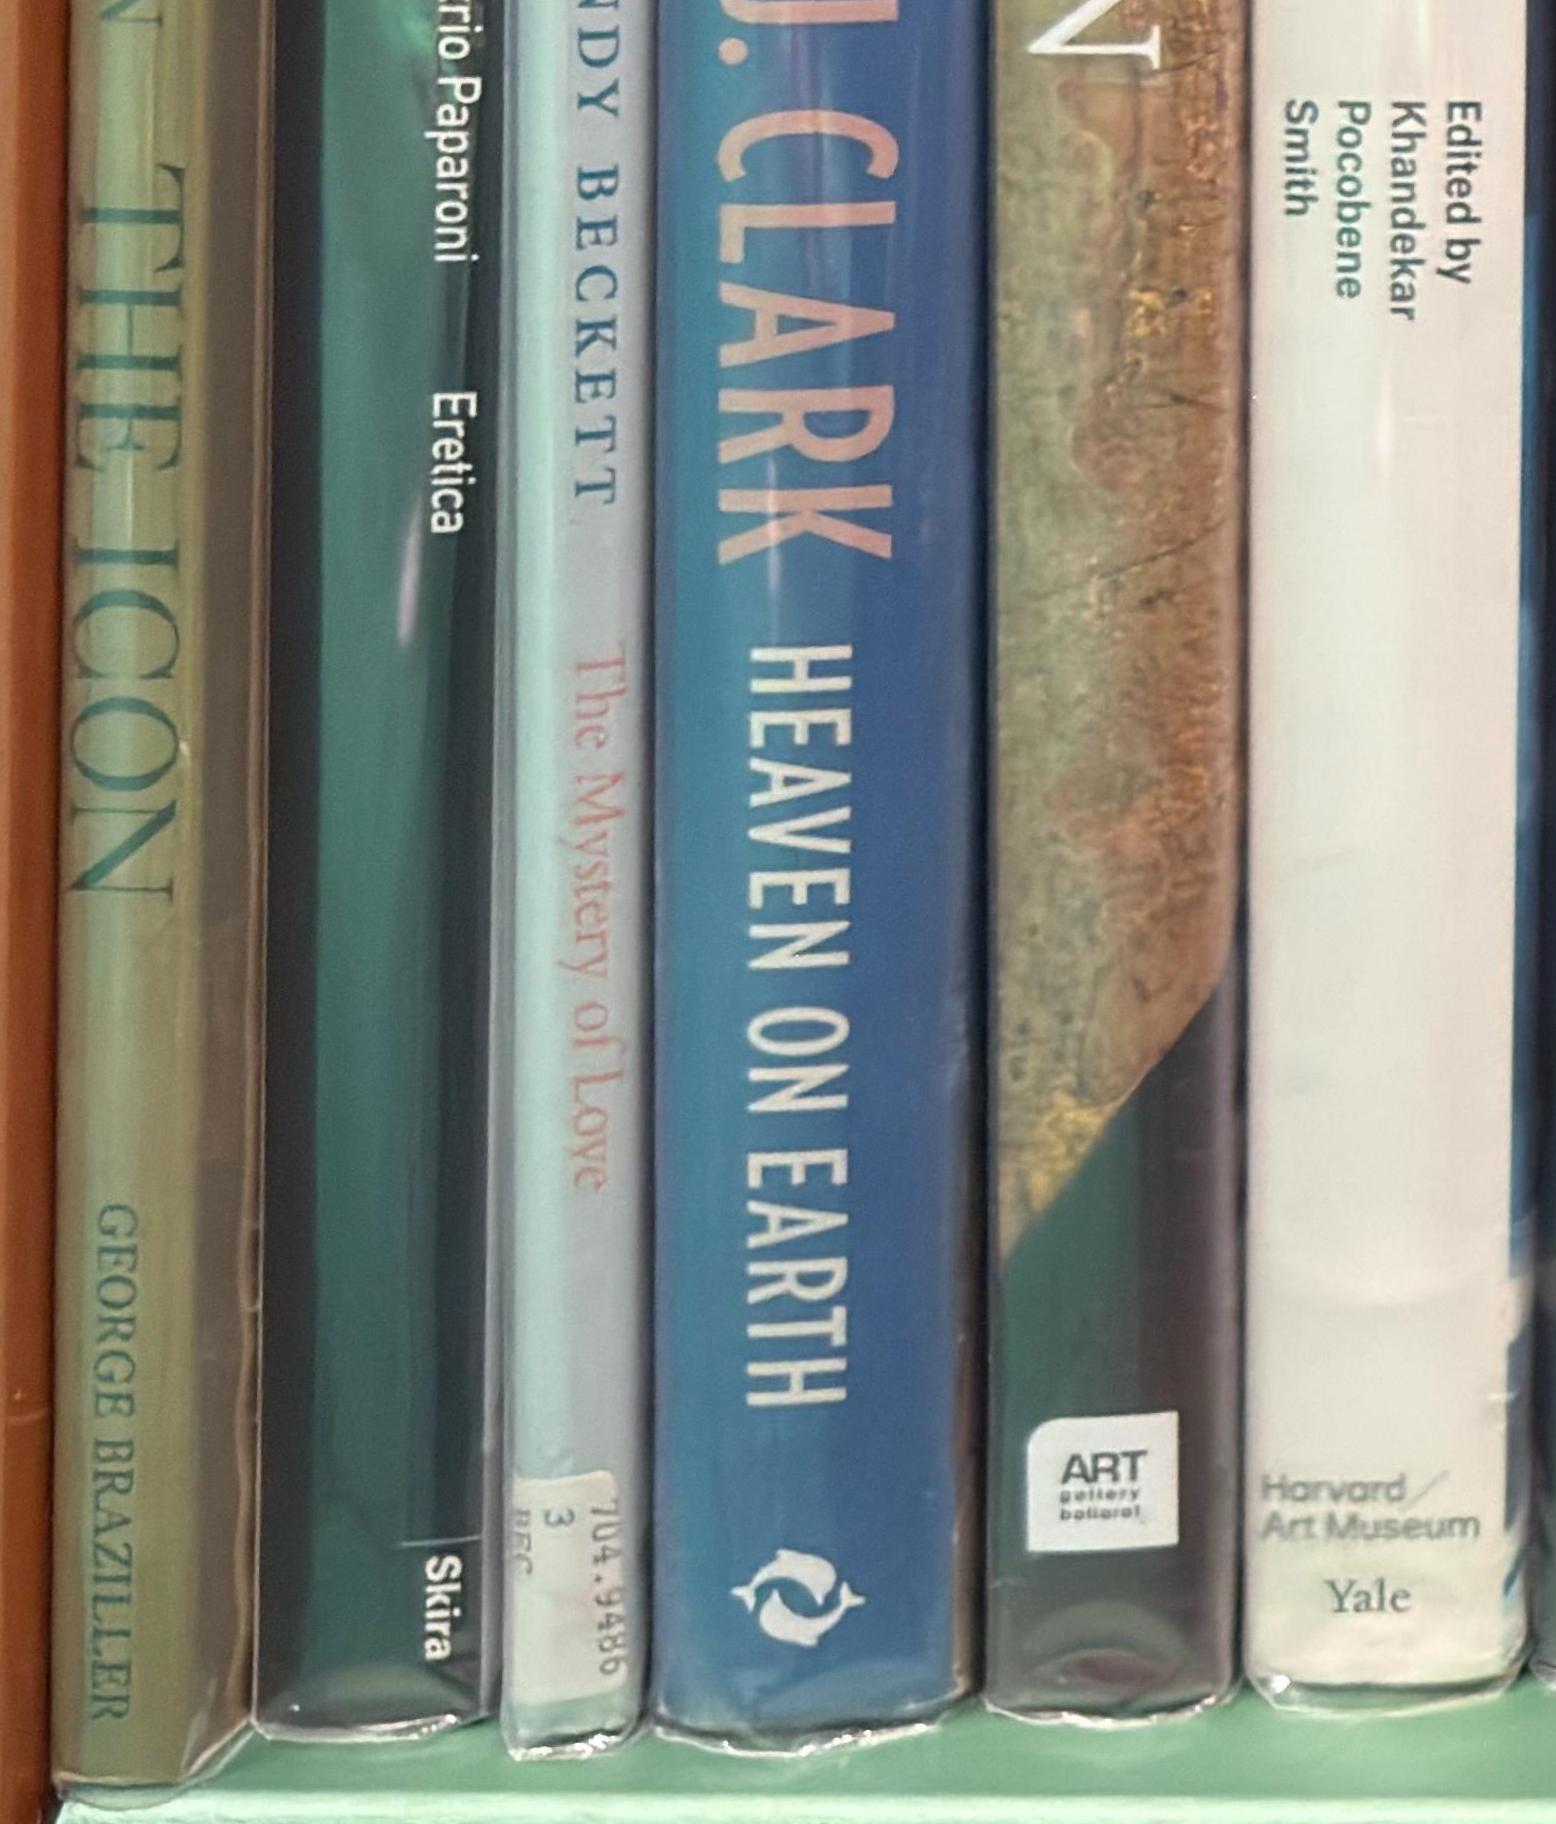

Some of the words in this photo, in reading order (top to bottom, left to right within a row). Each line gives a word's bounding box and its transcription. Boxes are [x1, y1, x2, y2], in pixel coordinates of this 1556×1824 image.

[424, 74, 482, 263] Paparoni
[1285, 101, 1318, 217] Smith
[1337, 101, 1371, 299] Pocobene
[1390, 103, 1425, 321] Khandekar
[1446, 103, 1481, 219] Edited
[73, 162, 187, 469] THE
[572, 167, 620, 503] BECKETT
[719, 109, 899, 563] CLARK
[1439, 234, 1481, 285] by
[432, 392, 476, 534] Eretica
[69, 542, 183, 905] ICON
[573, 642, 626, 750] The
[560, 766, 624, 981] Mystery
[750, 642, 851, 971] HEAVEN
[568, 999, 624, 1060] of
[749, 1011, 849, 1113] ON
[571, 1067, 625, 1189] Love
[97, 1202, 137, 1419] GEORGE
[746, 1153, 849, 1407] EARTH
[1062, 1450, 1148, 1482] ART
[1262, 1511, 1316, 1539] Art
[1324, 1512, 1479, 1539] Museum
[91, 1438, 135, 1724] BRAZILLER
[424, 1553, 461, 1662] Skira
[1324, 1580, 1411, 1613] Yale
